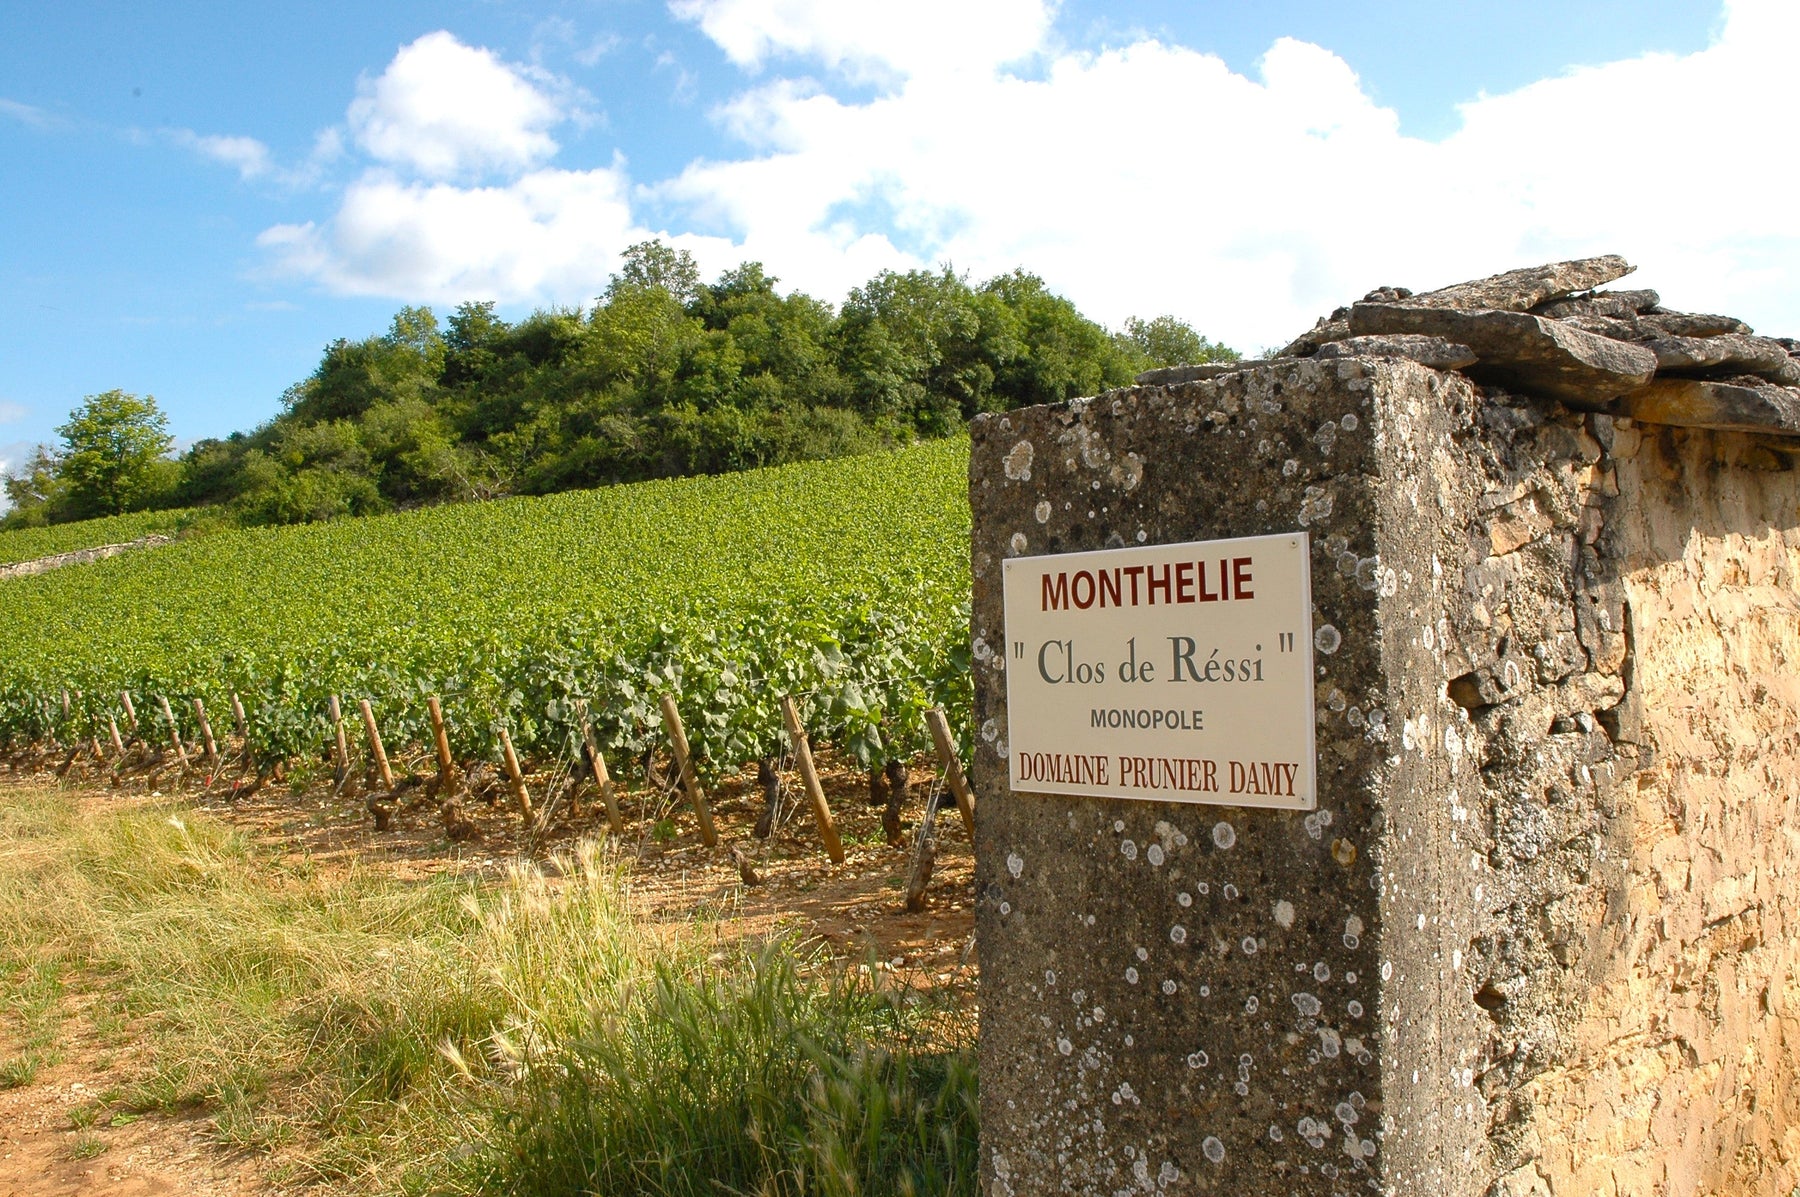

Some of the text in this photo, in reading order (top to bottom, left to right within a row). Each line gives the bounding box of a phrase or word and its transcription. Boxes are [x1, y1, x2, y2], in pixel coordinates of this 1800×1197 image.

[1041, 557, 1255, 612] MONTHELIE
[1037, 639, 1105, 684] Clos
[1118, 637, 1155, 683] de
[1166, 636, 1265, 682] Réssi
[1090, 708, 1204, 730] MONOPOLE
[1019, 752, 1299, 796] DOMAINE PRUNIER DAMY
